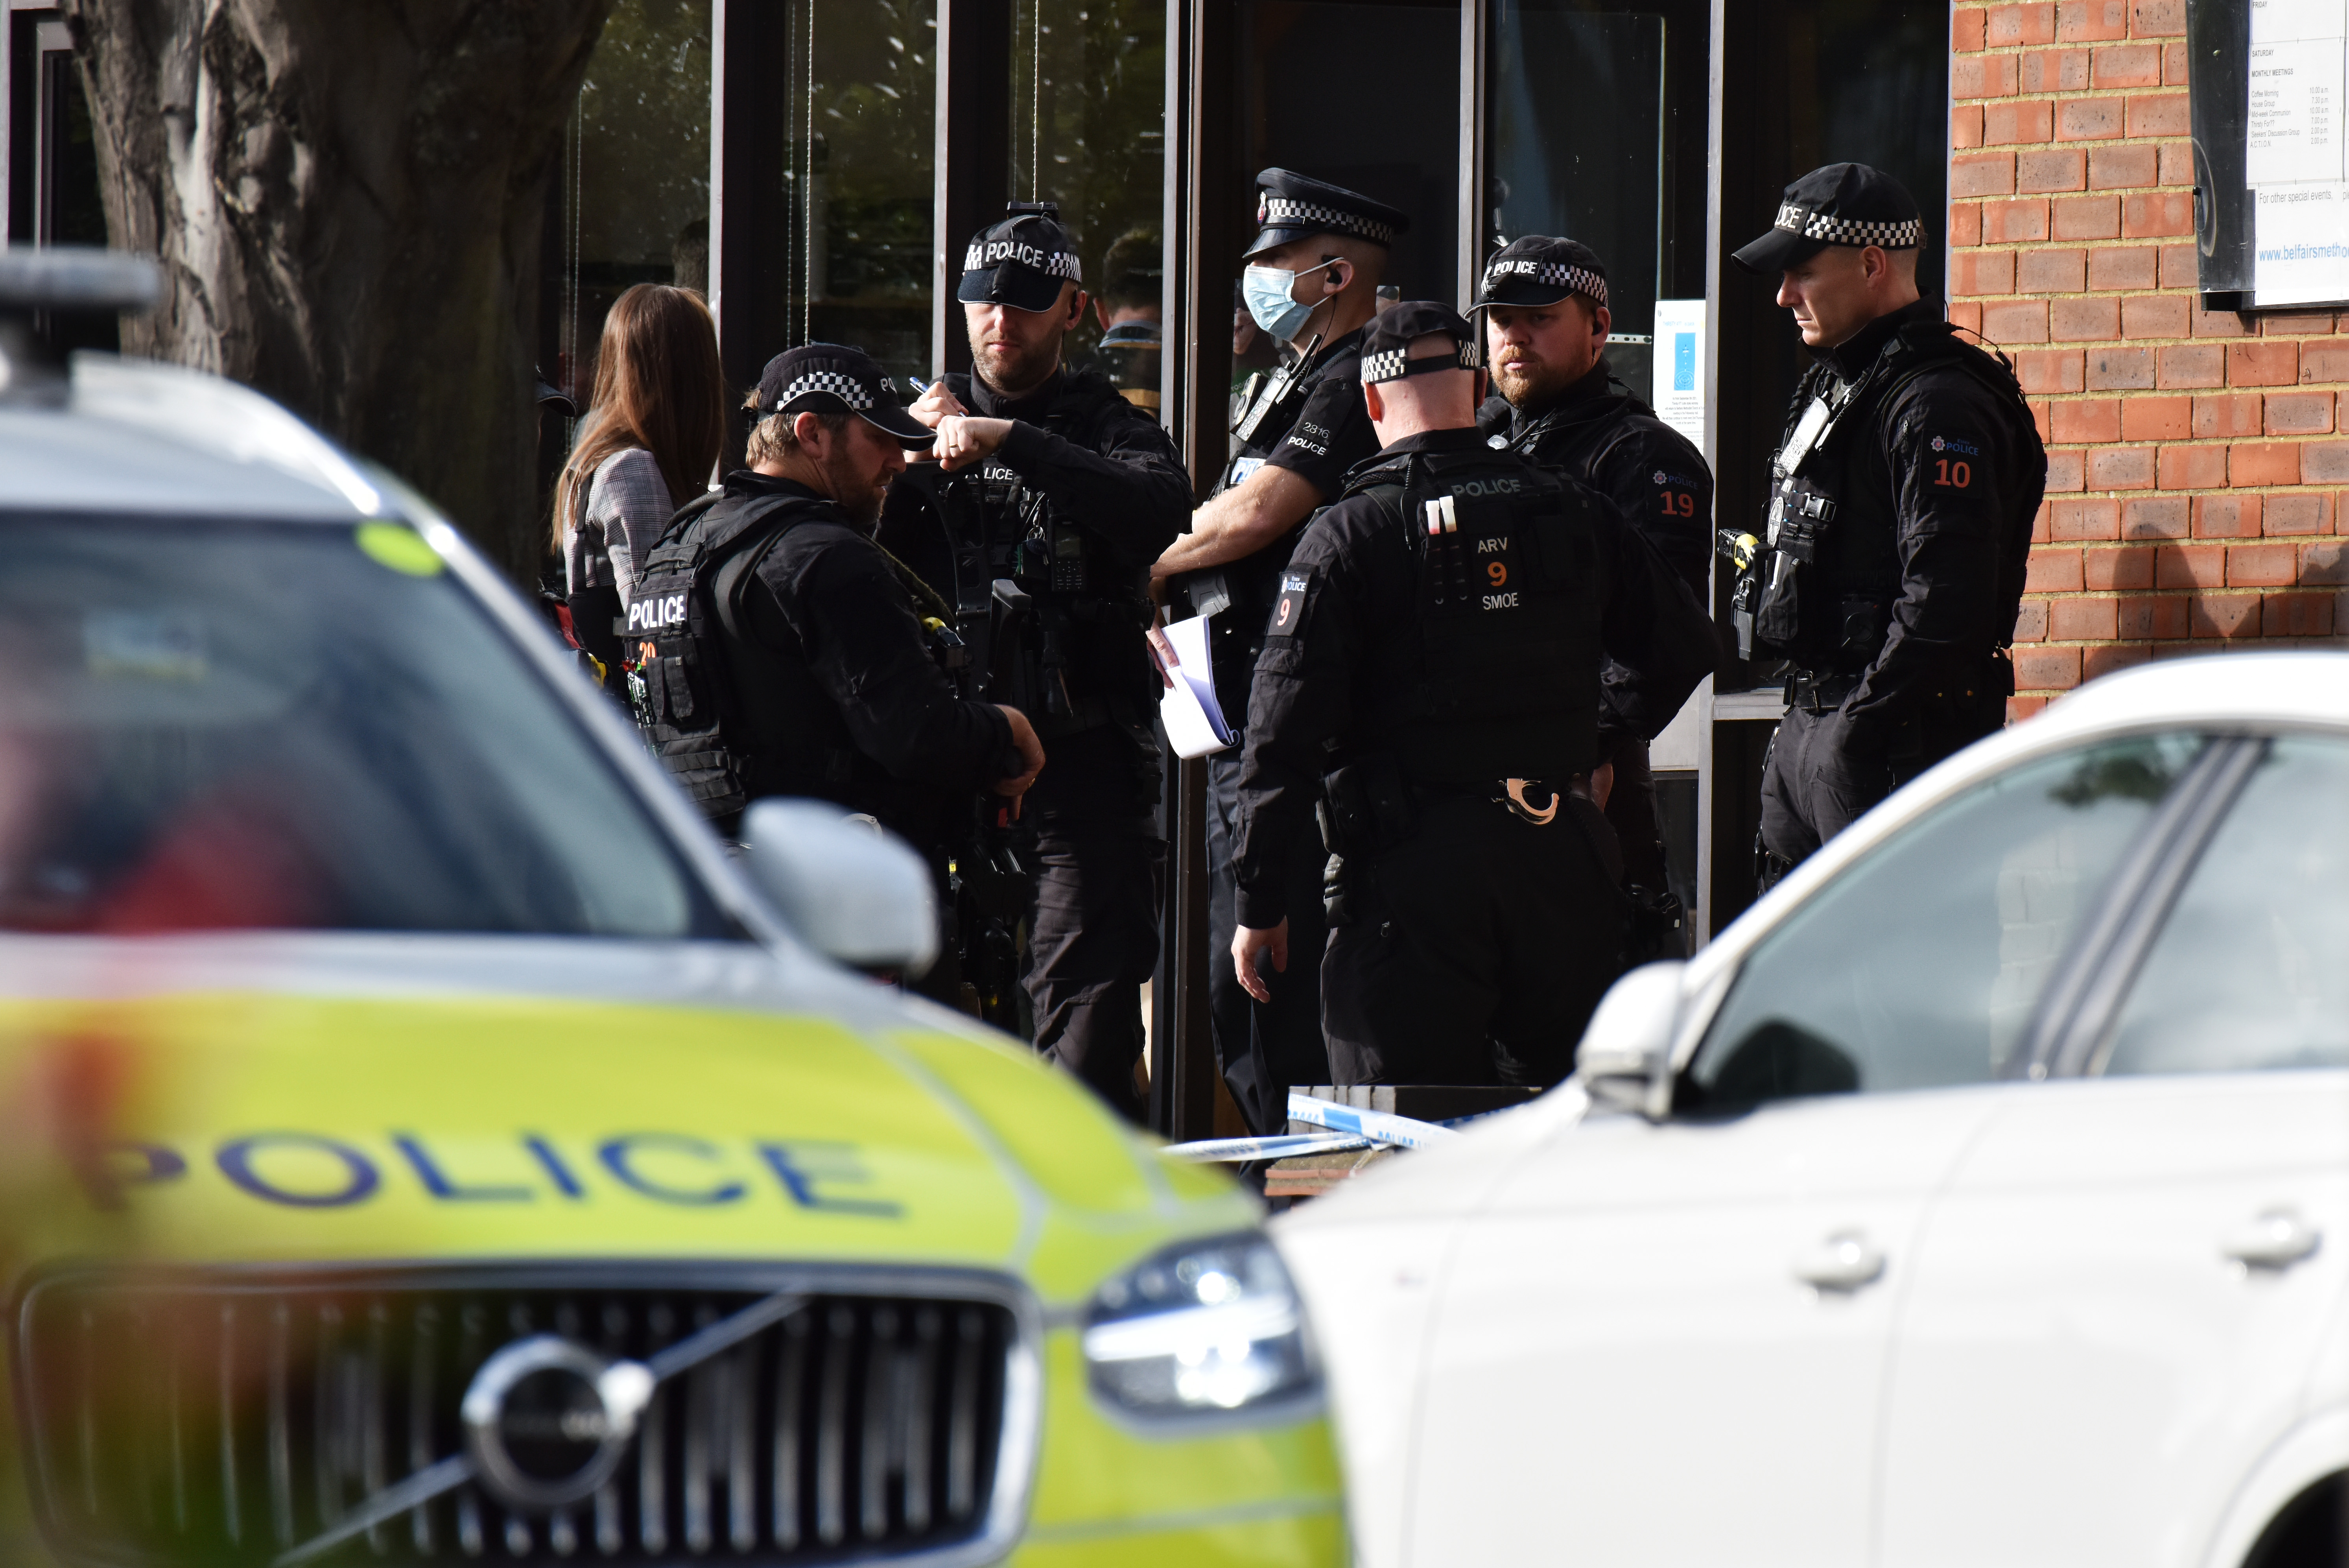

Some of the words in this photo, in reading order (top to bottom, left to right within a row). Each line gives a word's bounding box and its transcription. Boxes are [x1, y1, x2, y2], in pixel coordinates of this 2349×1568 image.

[2252, 49, 2274, 57] SATURDAY
[2252, 69, 2271, 77] MONTHLY
[2260, 193, 2269, 203] For
[2270, 192, 2286, 203] other
[2288, 190, 2309, 204] special
[2311, 190, 2333, 201] events,
[986, 242, 1043, 268] POLICE
[1493, 261, 1538, 275] POLICE
[1303, 422, 1329, 438] 2816
[1287, 436, 1327, 456] POLICE
[1946, 442, 1978, 456] POLICE
[1669, 475, 1698, 490] POLICE
[1934, 459, 1970, 488] 10
[1451, 479, 1521, 497] POLICE
[1660, 491, 1693, 517] 19
[1478, 537, 1507, 554] ARV
[1488, 562, 1507, 586] 9
[1287, 581, 1306, 591] POLICE
[1482, 592, 1519, 610] SMOE
[629, 595, 685, 630] POLICE
[1277, 598, 1291, 626] 9
[77, 1129, 907, 1217] POLICE
